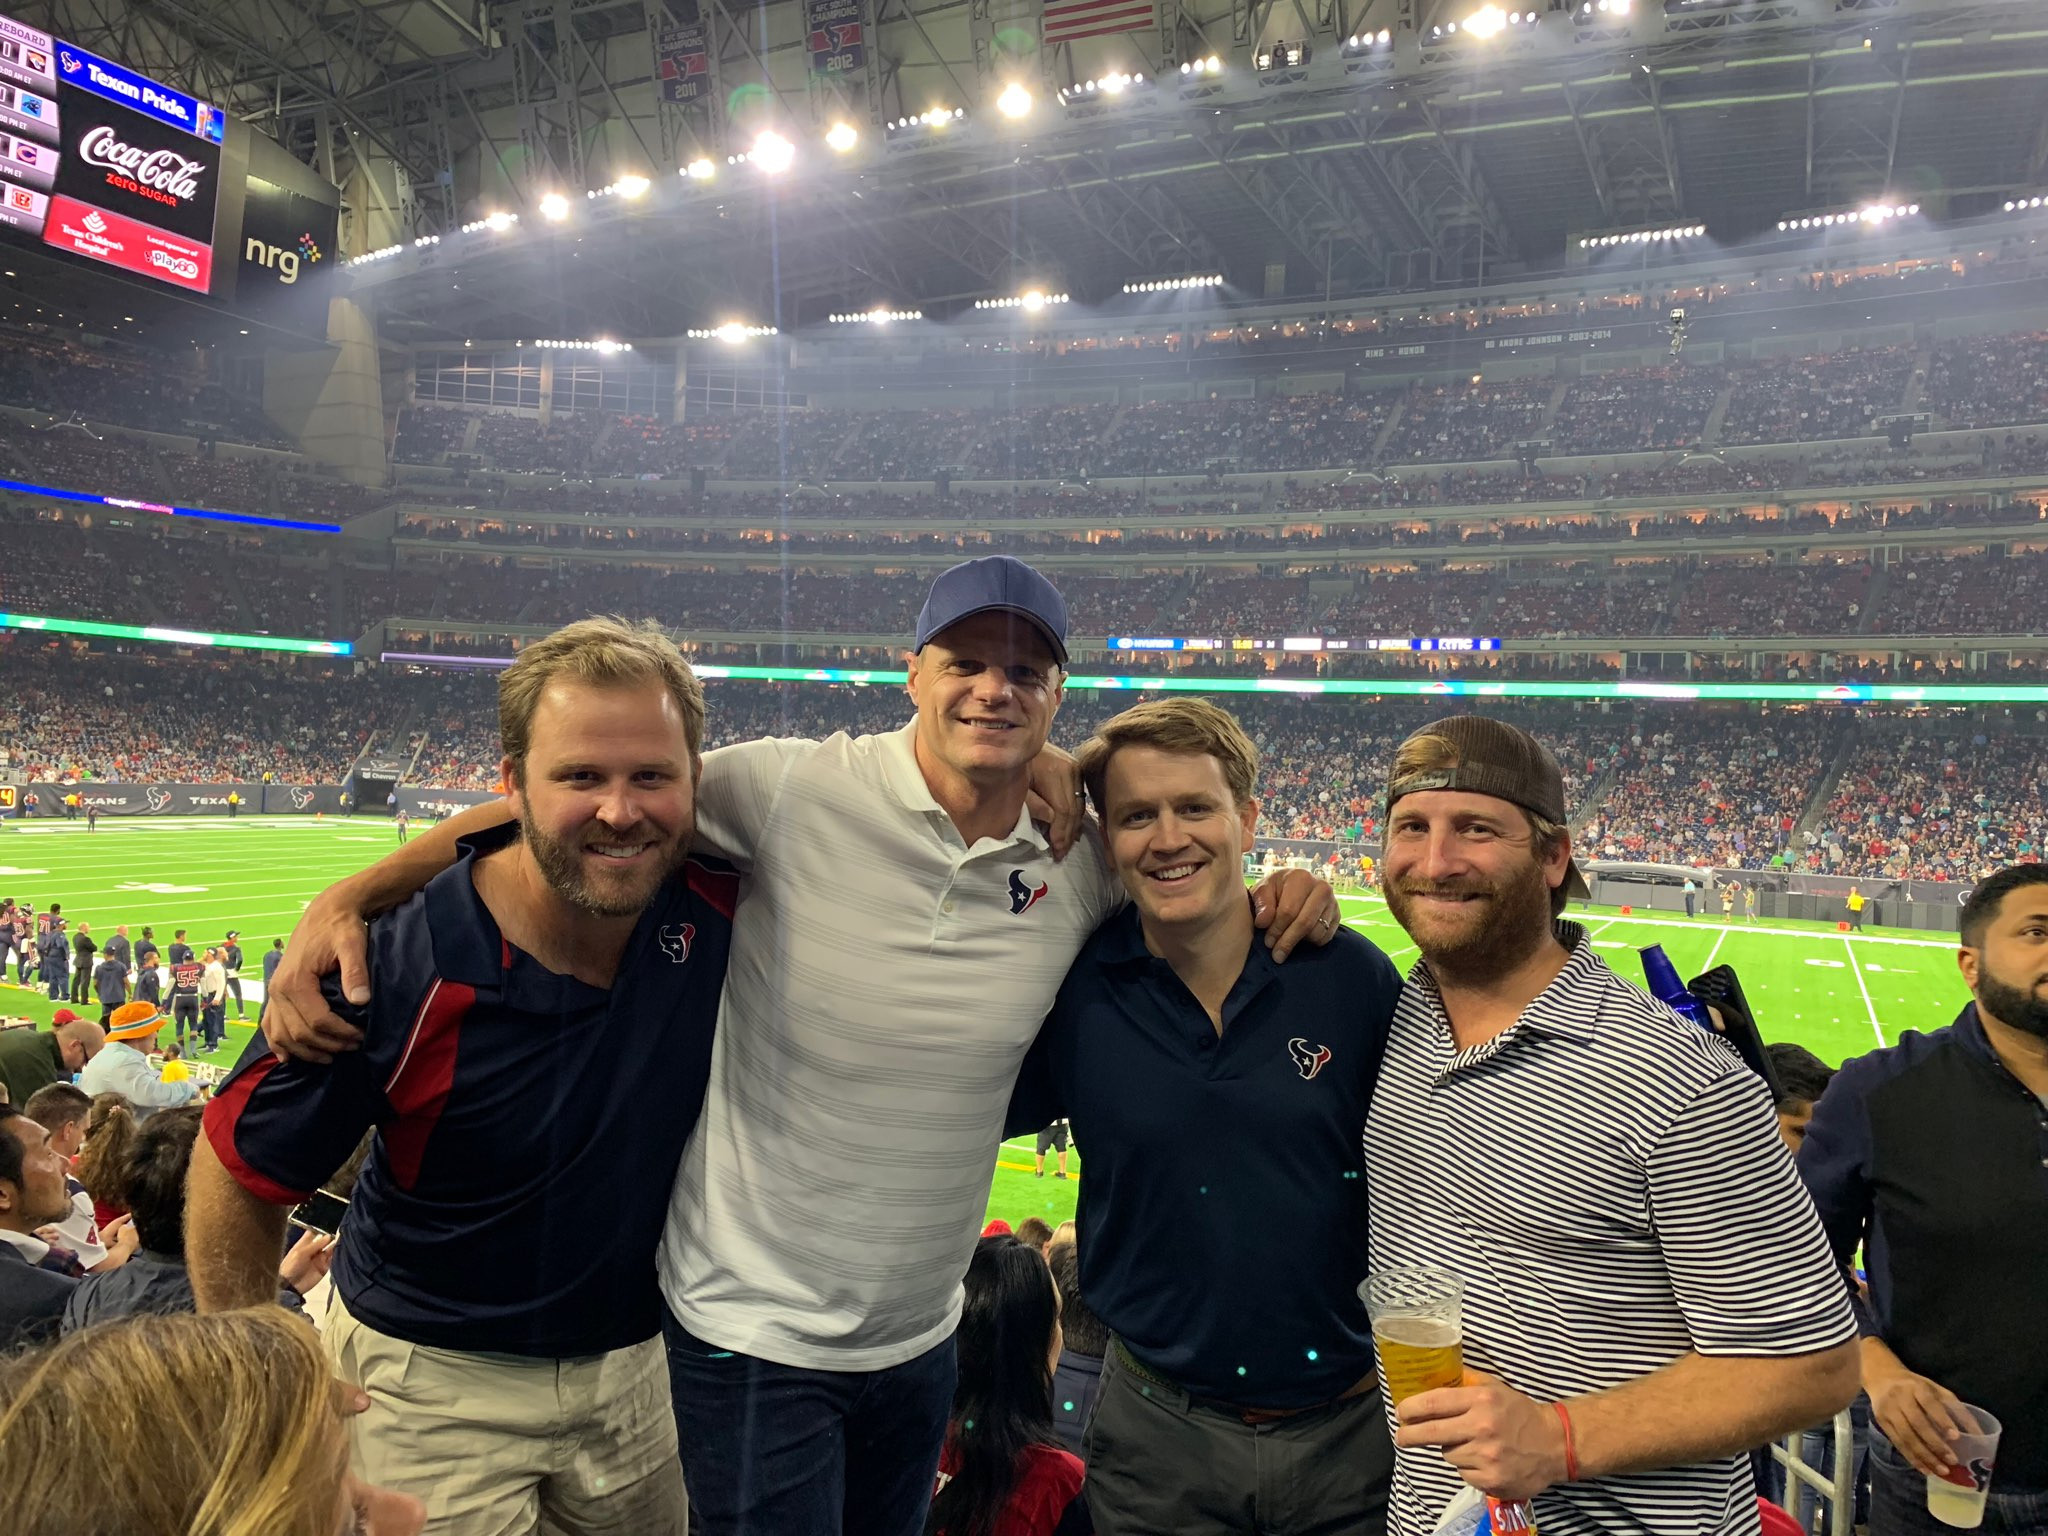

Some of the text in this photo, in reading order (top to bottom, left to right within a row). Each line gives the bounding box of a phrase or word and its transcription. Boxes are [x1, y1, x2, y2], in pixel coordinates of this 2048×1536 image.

[811, 6, 858, 22] CHAMPIONS
[661, 37, 704, 50] CHAMPIONS
[664, 33, 677, 42] AFC
[826, 54, 854, 72] 2012
[14, 71, 23, 82] AM
[24, 74, 32, 84] ET
[88, 63, 189, 121] Texan Pride.
[675, 82, 696, 99] 2011
[9, 115, 18, 126] PM
[19, 119, 28, 130] ET
[80, 126, 206, 201] Coca-Cola
[14, 169, 22, 178] ET
[106, 173, 178, 208] zero SUGAR
[10, 216, 18, 225] ET
[61, 224, 124, 252] Texas Children's
[146, 234, 165, 247] Local
[190, 249, 199, 257] of
[74, 238, 109, 256] Hospital
[246, 237, 300, 284] nrg
[1526, 334, 1562, 346] JOHNSON
[1365, 345, 1425, 358] RING HONOR
[372, 772, 396, 780] Chevron
[189, 796, 246, 806] TEXAS
[177, 970, 200, 988] 55
